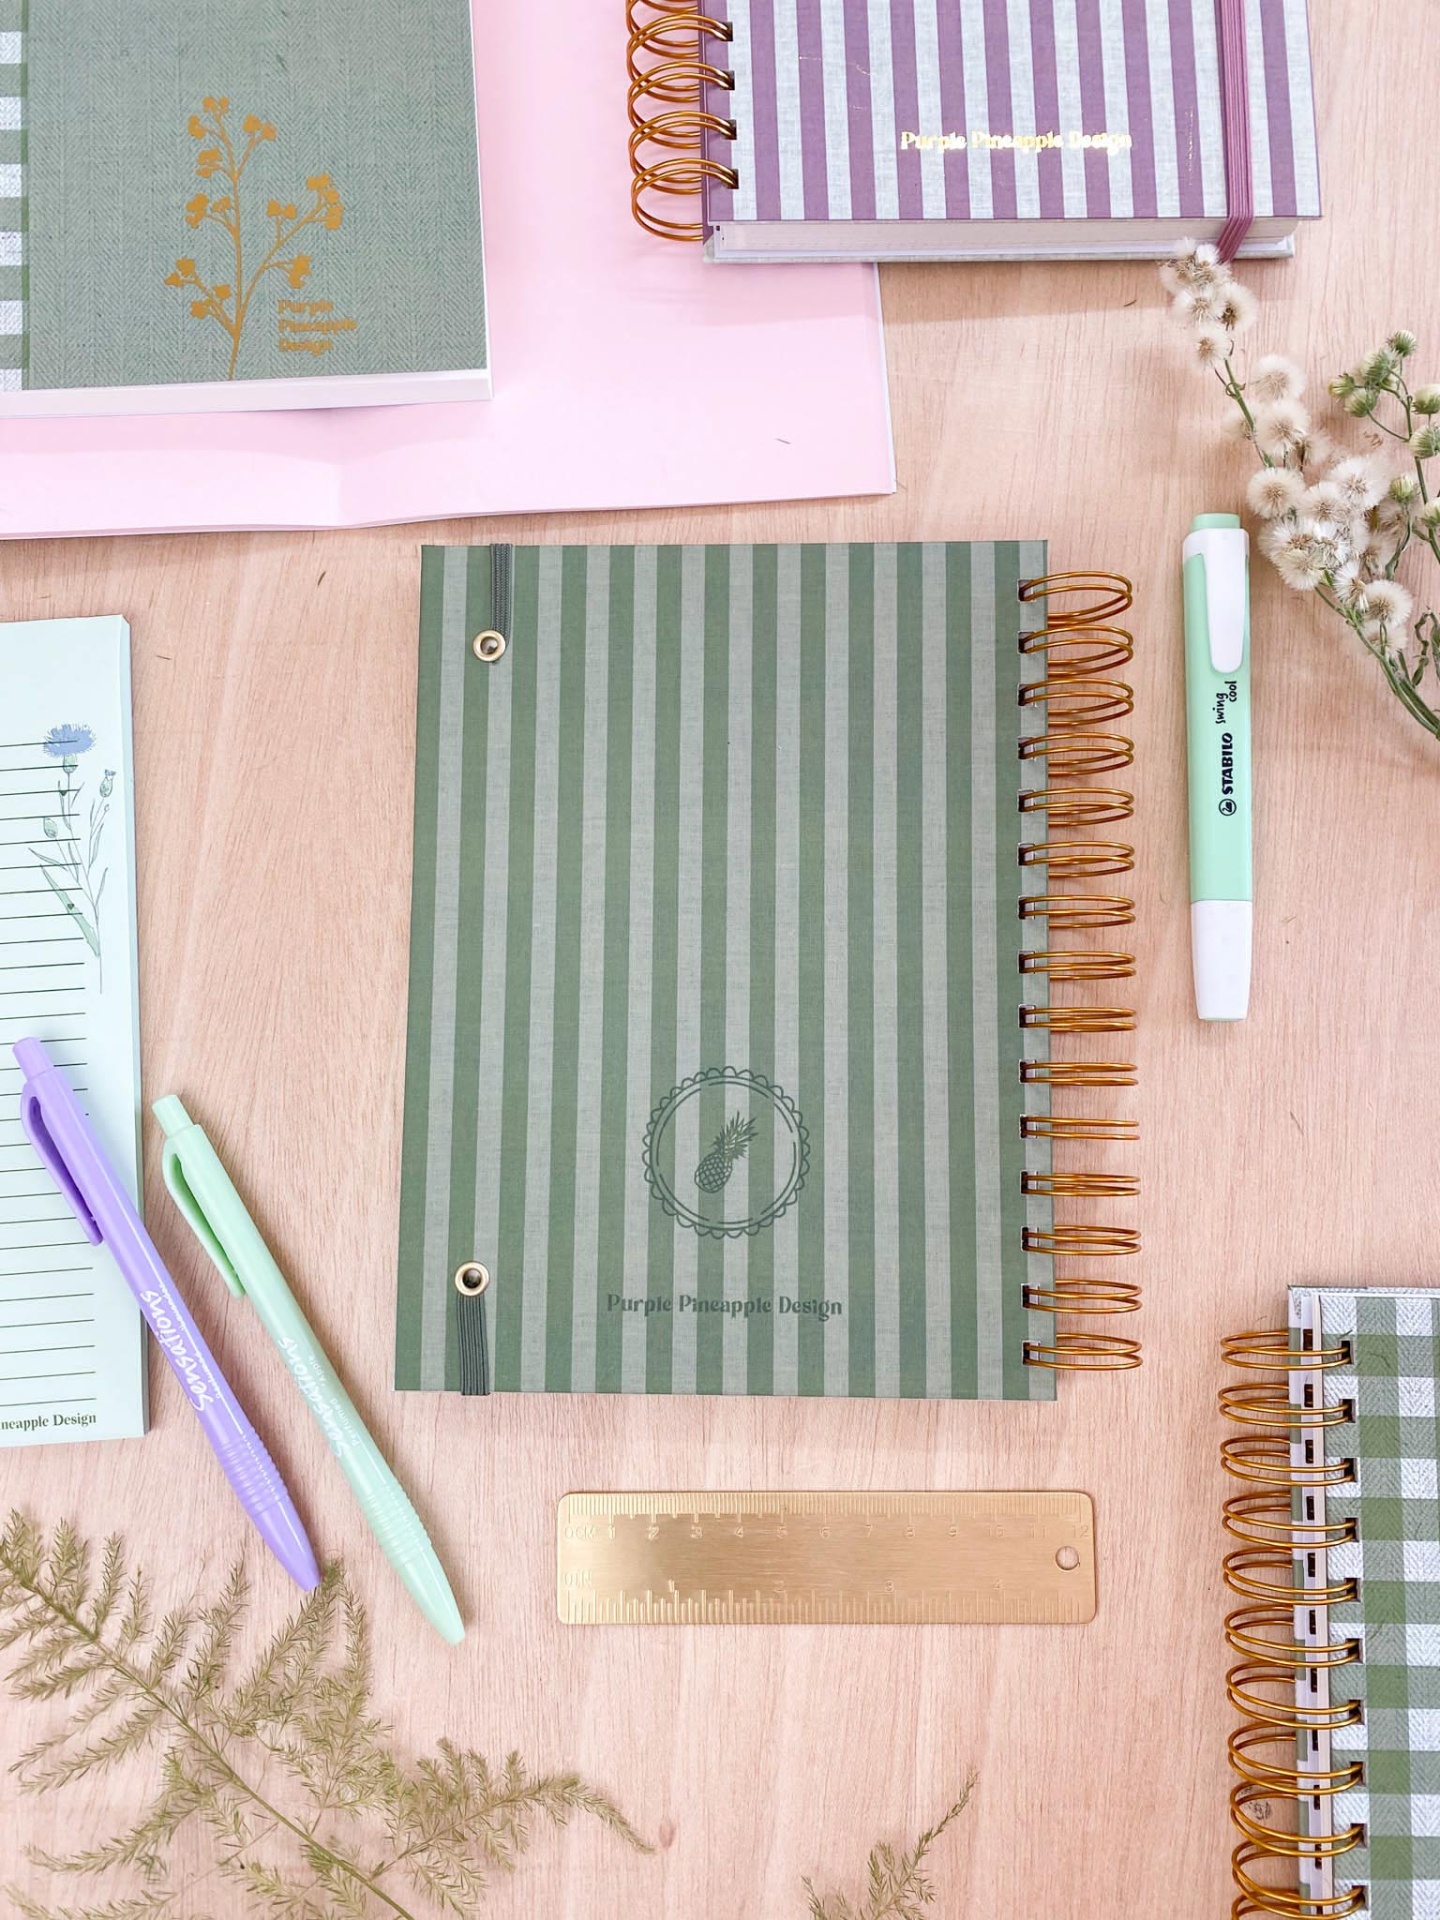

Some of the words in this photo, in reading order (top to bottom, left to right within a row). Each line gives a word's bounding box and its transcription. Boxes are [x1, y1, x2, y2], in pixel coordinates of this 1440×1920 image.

[901, 131, 967, 154] Purple
[972, 131, 1064, 154] Pineapple
[1068, 131, 1133, 156] Design
[277, 299, 334, 317] Purple
[1224, 680, 1238, 702] cool
[1212, 692, 1229, 724] swing
[1221, 732, 1234, 795] STABILO
[607, 1294, 673, 1316] Purple
[679, 1294, 772, 1319] Pineapple
[779, 1296, 843, 1322] Design
[140, 1290, 214, 1411] Sensations
[278, 1337, 350, 1457] Sensations
[53, 1412, 97, 1427] Design
[646, 1525, 660, 1540] 2
[689, 1525, 703, 1540] 3
[733, 1526, 745, 1539] 4
